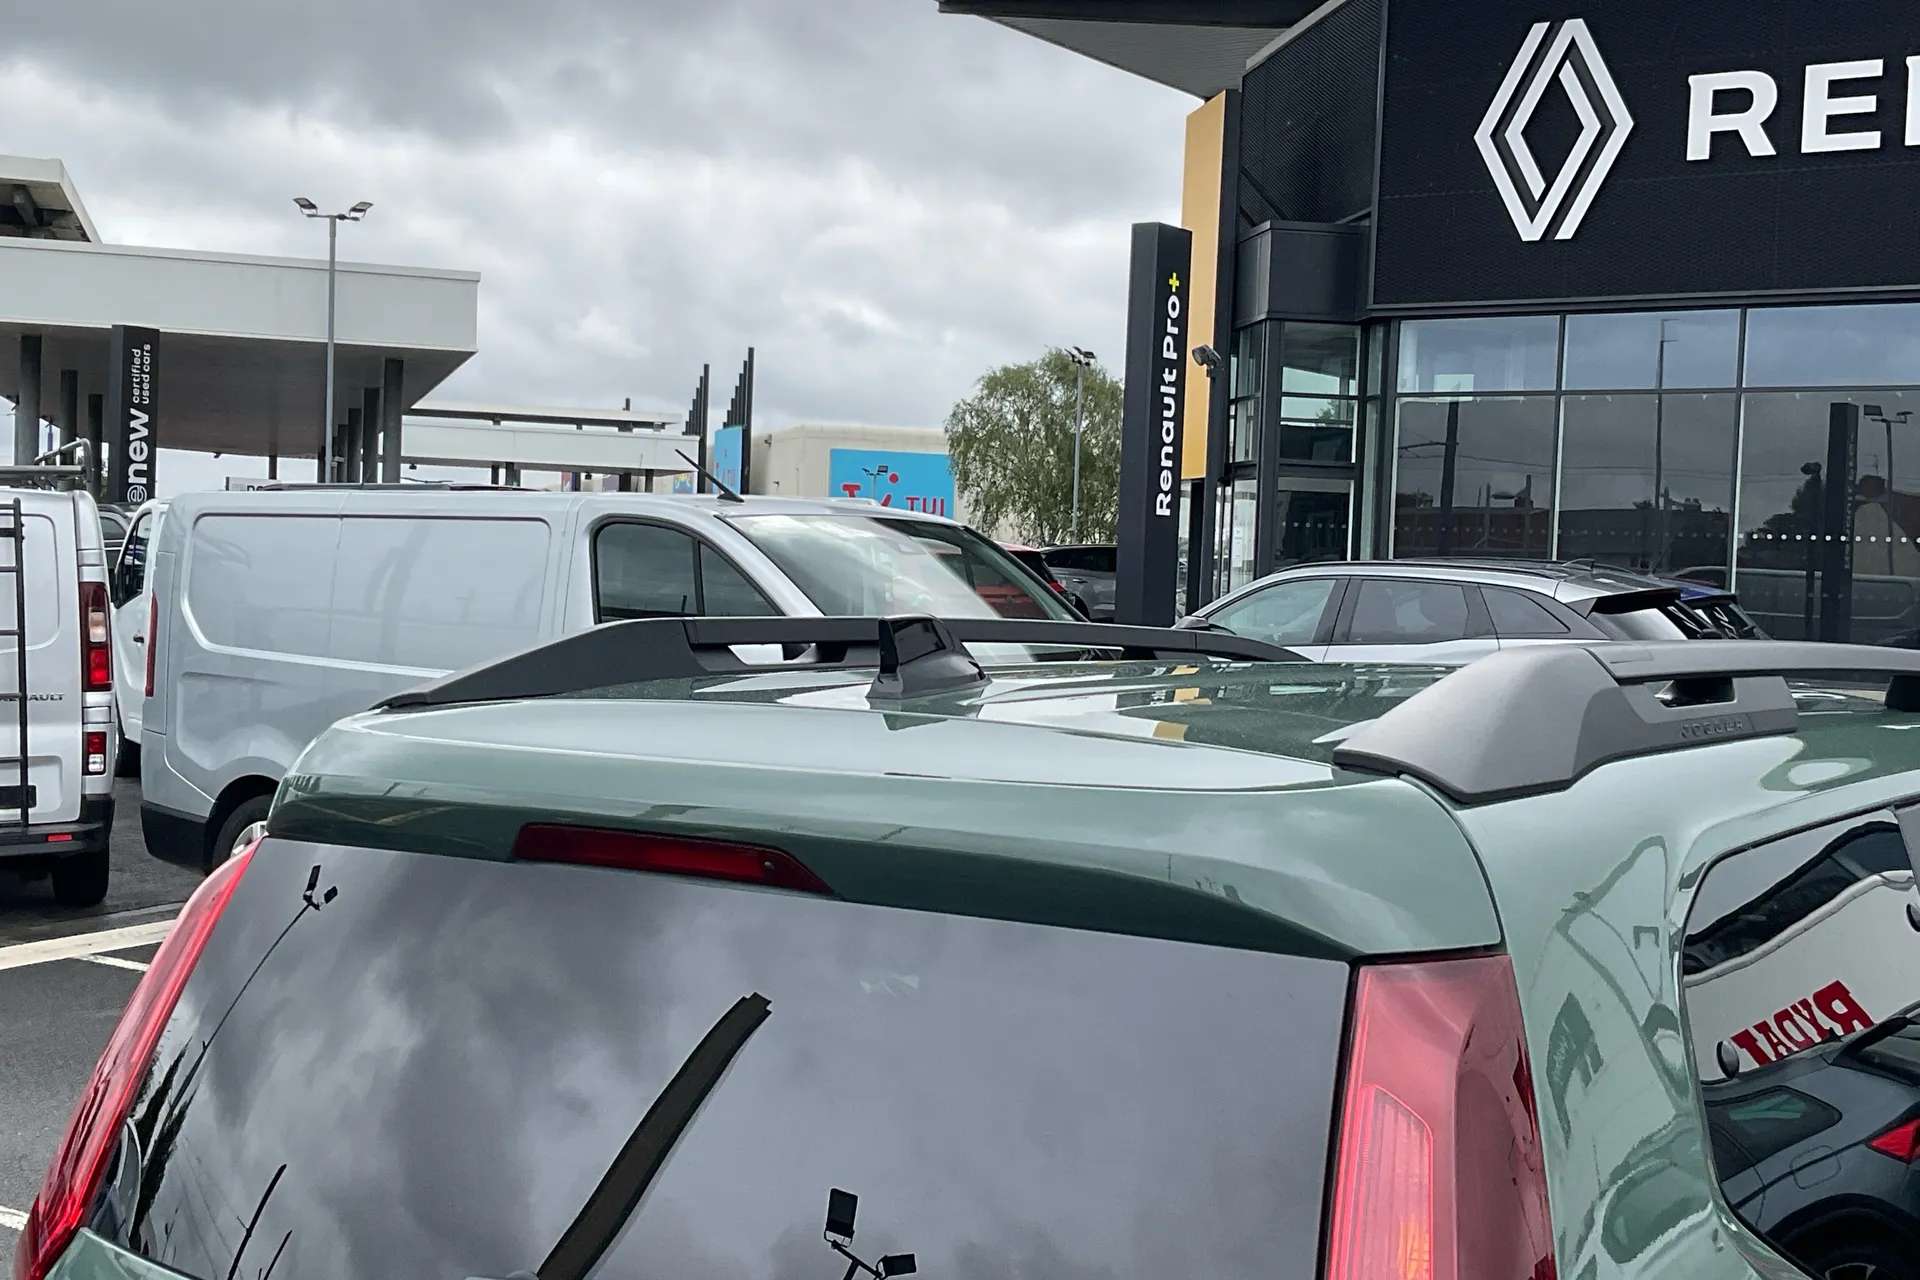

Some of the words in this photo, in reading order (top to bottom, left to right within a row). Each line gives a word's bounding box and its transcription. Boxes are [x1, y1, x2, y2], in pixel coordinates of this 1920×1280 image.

[1686, 56, 1920, 161] RE
[131, 348, 142, 404] certified
[143, 343, 151, 372] cars
[141, 373, 150, 405] used
[1155, 367, 1177, 516] Renault
[905, 495, 945, 517] TUI
